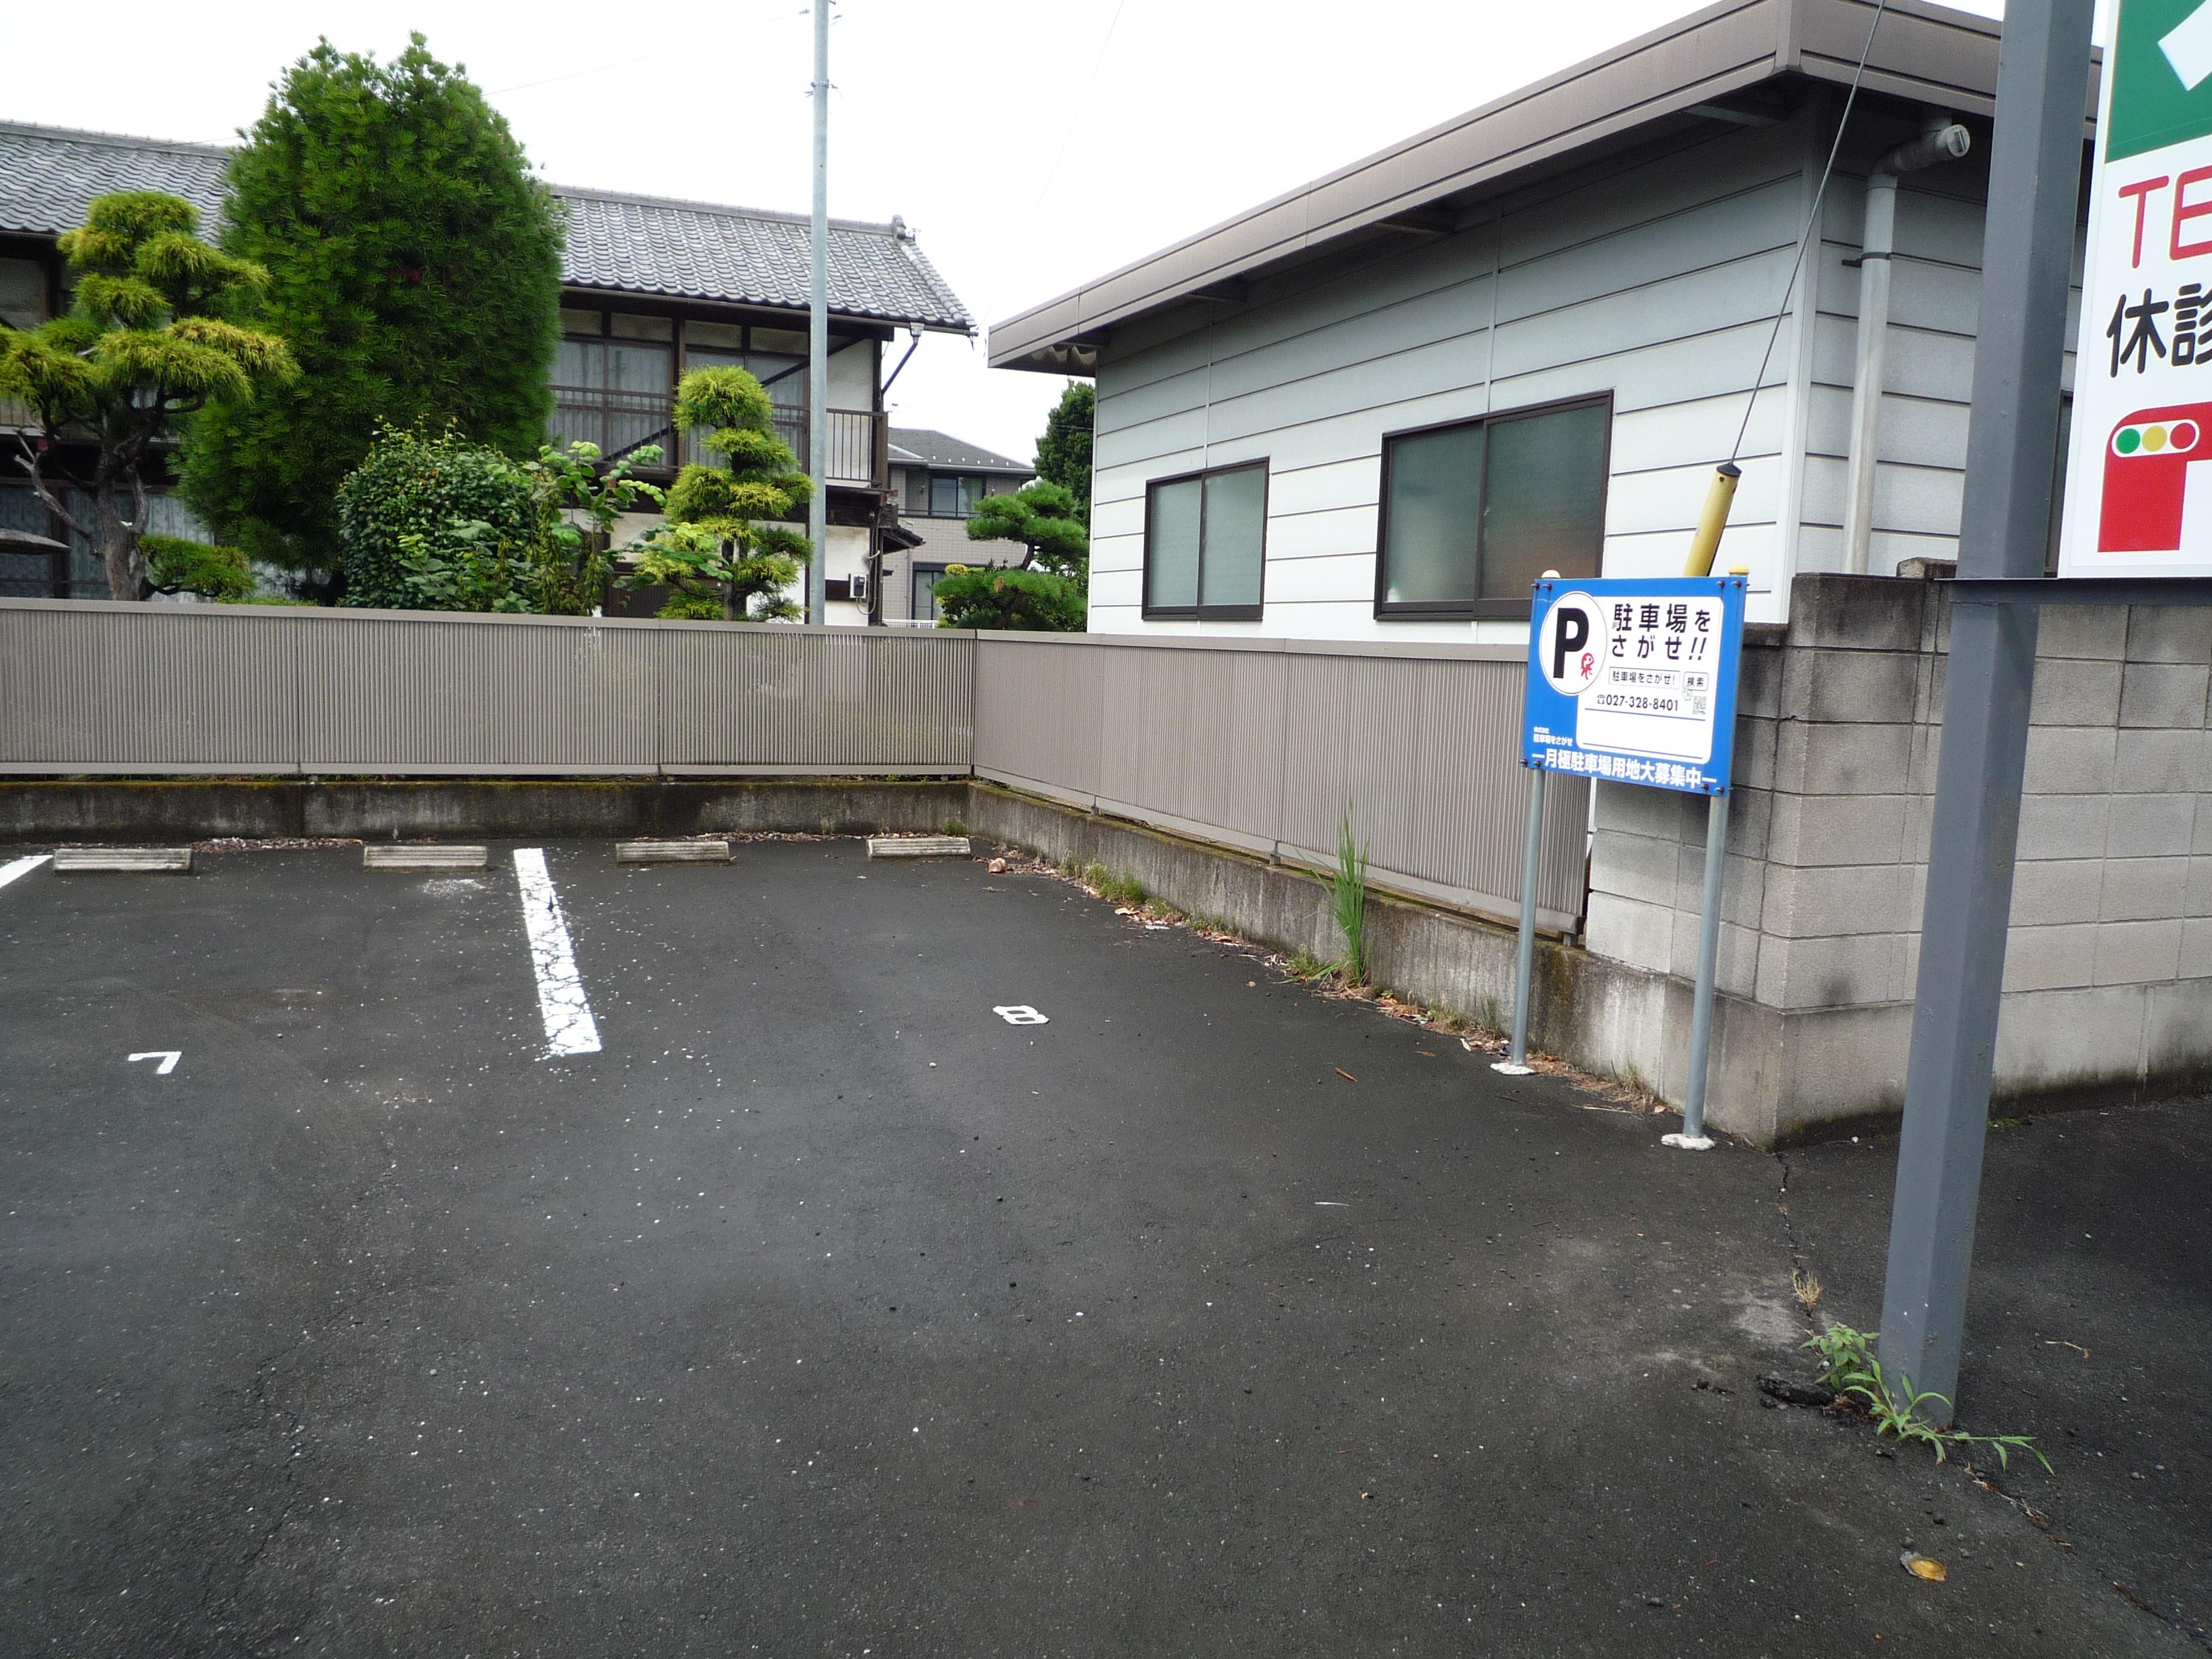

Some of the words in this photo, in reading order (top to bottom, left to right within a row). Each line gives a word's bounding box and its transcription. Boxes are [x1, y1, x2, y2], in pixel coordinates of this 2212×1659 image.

[1612, 603, 1711, 633] 駐車場を
[1553, 607, 1589, 679] P
[1606, 694, 1678, 711] 027-328-8401
[993, 1005, 1050, 1025] 8
[127, 1051, 182, 1074] 7
